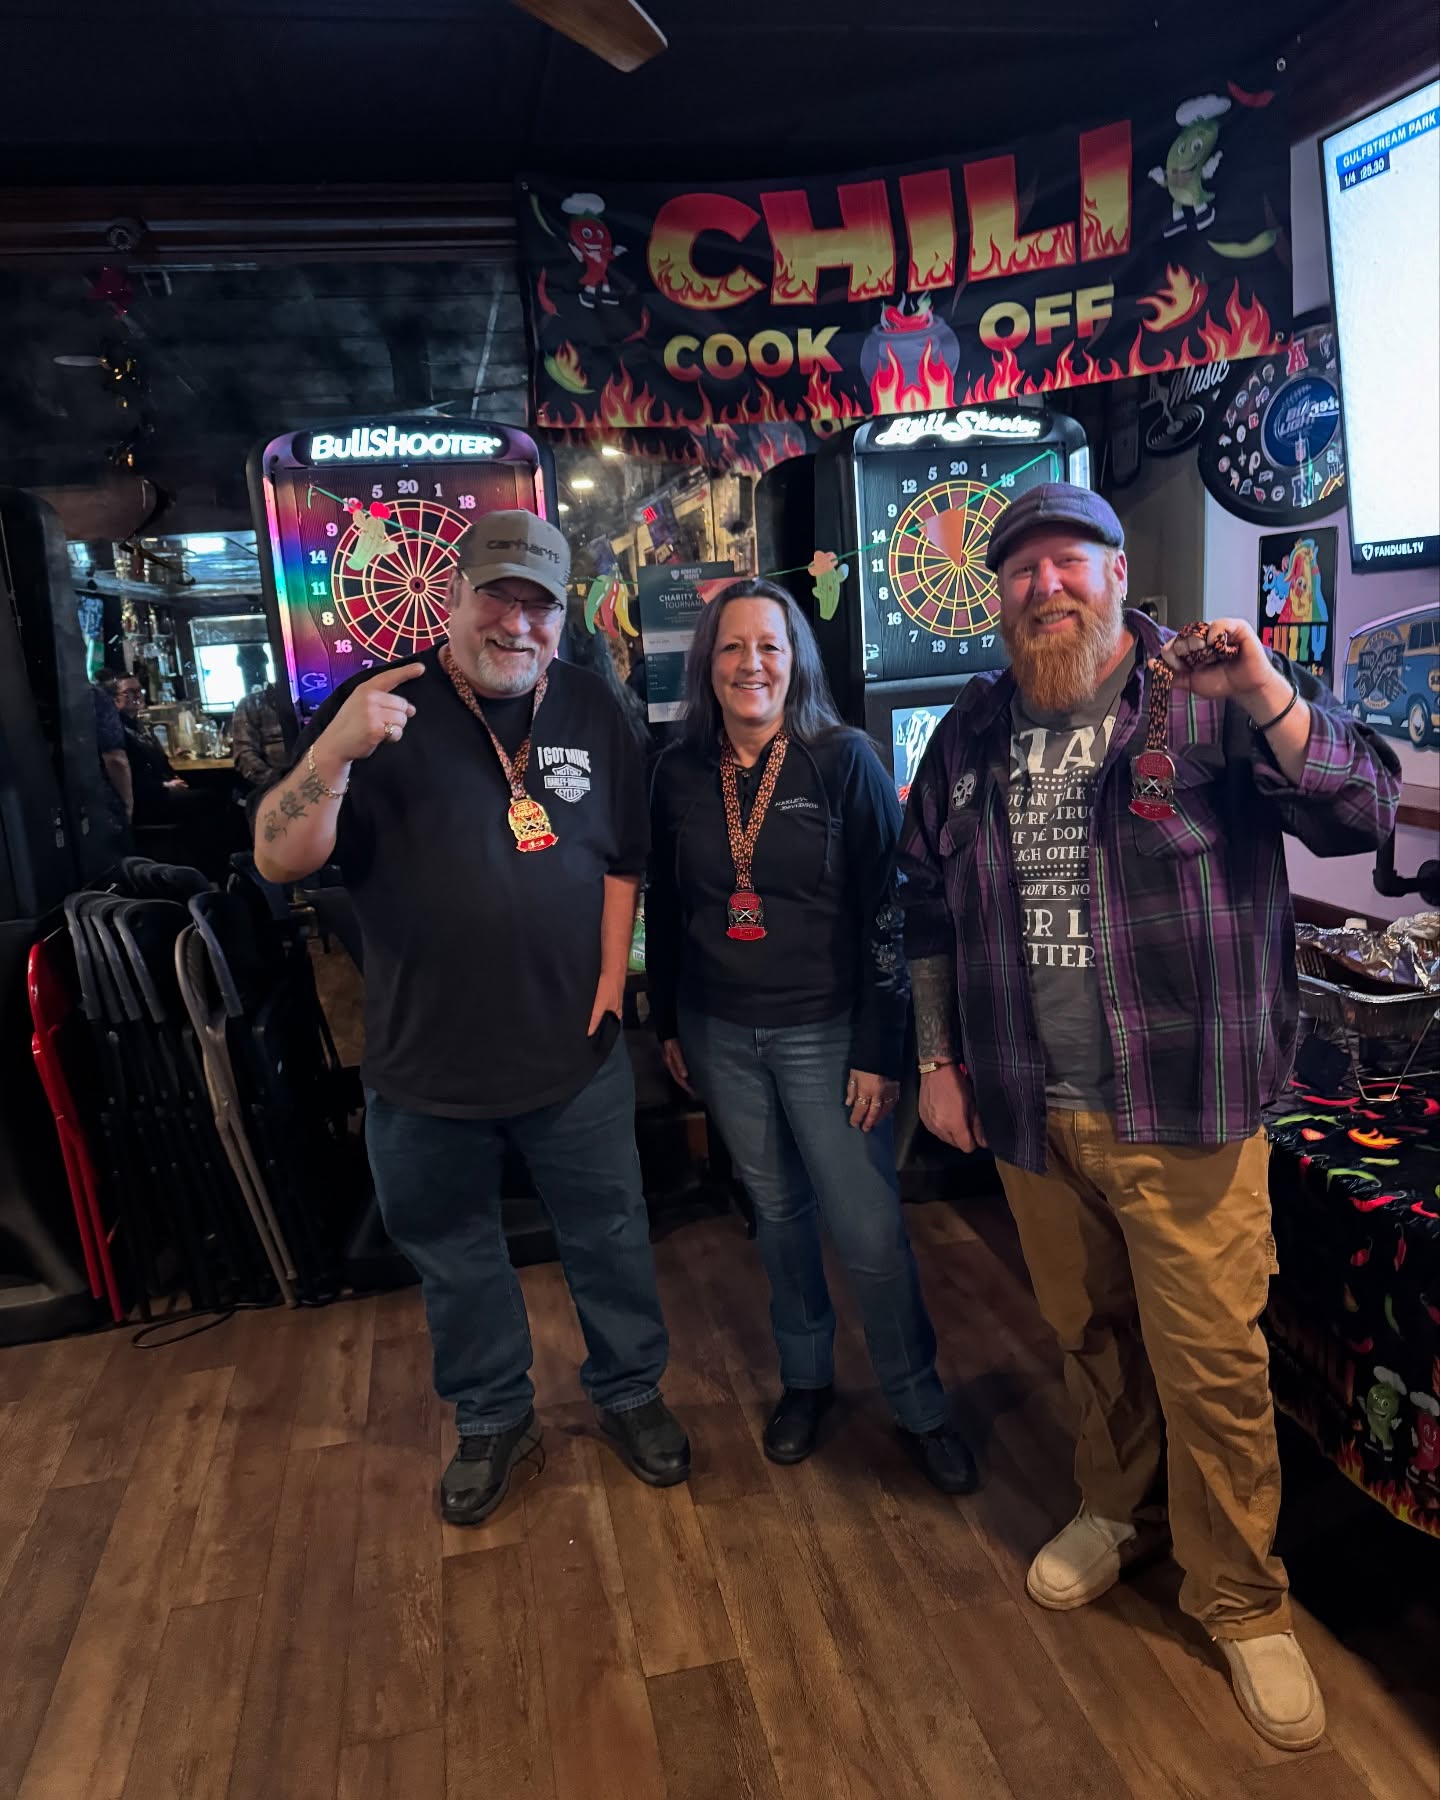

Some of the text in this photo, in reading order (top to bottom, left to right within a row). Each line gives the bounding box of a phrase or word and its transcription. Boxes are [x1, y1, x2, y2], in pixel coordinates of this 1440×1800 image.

[1408, 111, 1436, 136] PARK
[647, 119, 1133, 310] CHILI
[662, 285, 1116, 382] COOK OFF
[1170, 358, 1230, 408] Music
[928, 461, 988, 481] 5 20 1
[901, 480, 918, 494] 12
[1001, 474, 1016, 488] 18
[371, 479, 443, 499] 5 20 1
[458, 495, 476, 510] 18
[887, 504, 898, 518] 9
[326, 523, 338, 537] 9
[871, 530, 887, 544] 14
[309, 550, 327, 565] 14
[871, 559, 885, 573] 11
[311, 582, 327, 596] 11
[878, 587, 889, 601] 8
[659, 592, 693, 603] CHARITY
[321, 611, 335, 626] 8
[886, 612, 902, 626] 16
[908, 630, 919, 643] 7
[980, 635, 996, 649] 17
[333, 639, 353, 654] 16
[931, 639, 946, 653] 19
[958, 641, 969, 655] 3
[543, 747, 564, 766] GOT
[1052, 885, 1067, 896] IS
